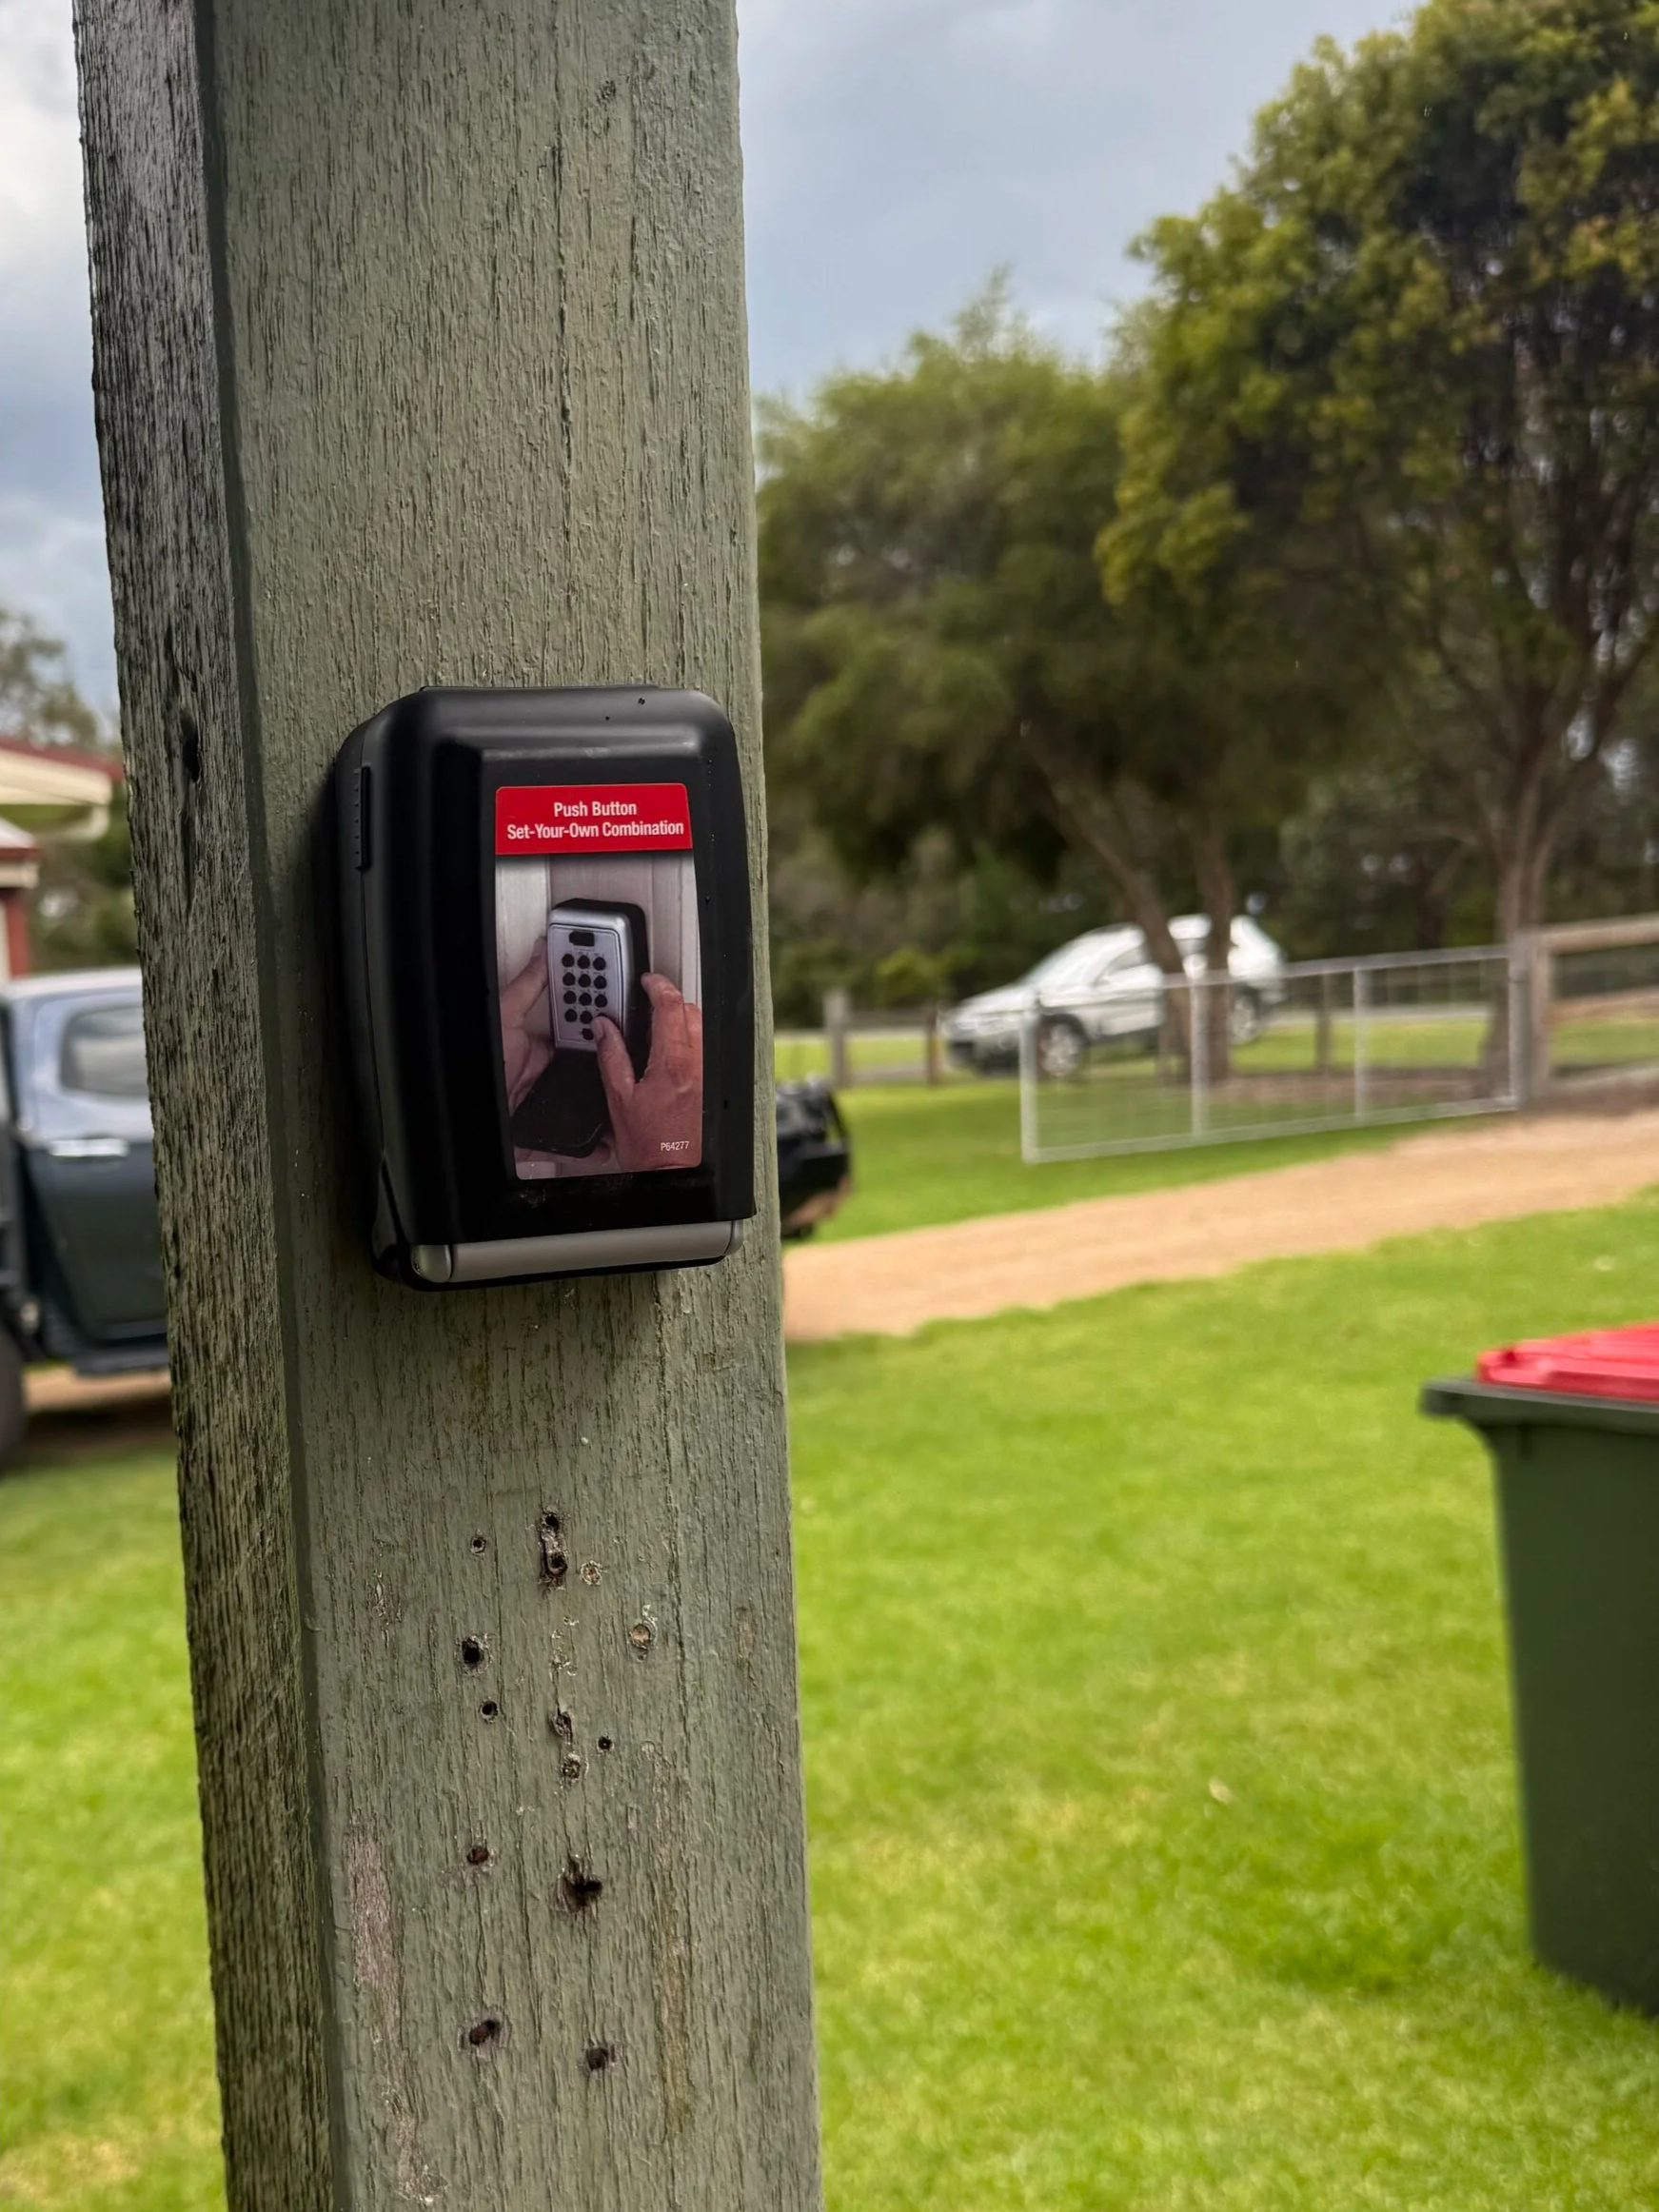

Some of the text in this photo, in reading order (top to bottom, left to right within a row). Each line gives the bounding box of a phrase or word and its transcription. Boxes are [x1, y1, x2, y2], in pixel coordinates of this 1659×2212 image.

[553, 800, 637, 818] Push Button
[506, 820, 684, 839] Set-Your-Own Combination
[660, 1140, 690, 1152] P64277
